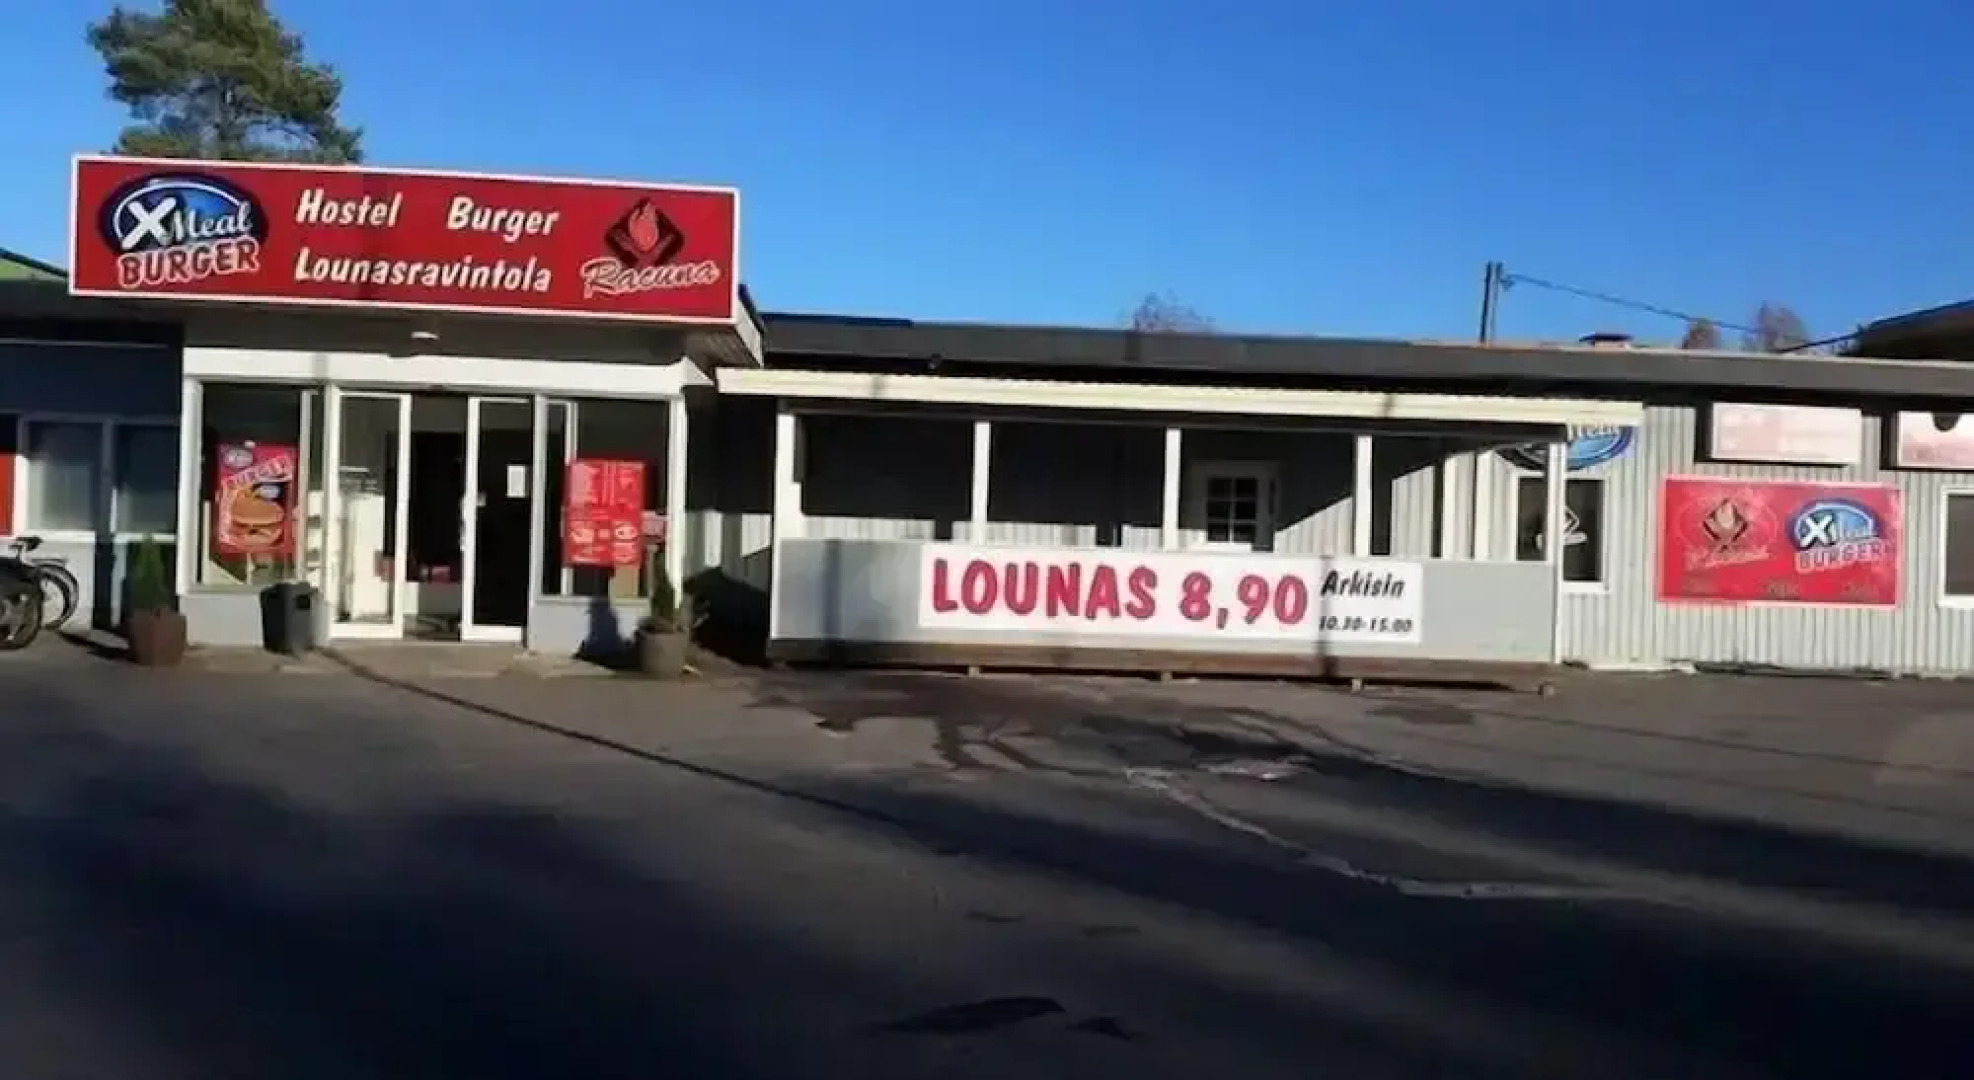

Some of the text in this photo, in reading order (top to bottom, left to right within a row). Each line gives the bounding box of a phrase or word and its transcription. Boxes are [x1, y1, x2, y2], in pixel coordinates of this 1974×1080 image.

[296, 188, 560, 242] Hostel Burger
[117, 233, 261, 289] BURGER
[294, 246, 552, 292] Lounasravintola
[579, 256, 721, 298] Racuna
[932, 558, 1308, 630] LOUNAS 8,90
[1320, 569, 1405, 598] Arkisin
